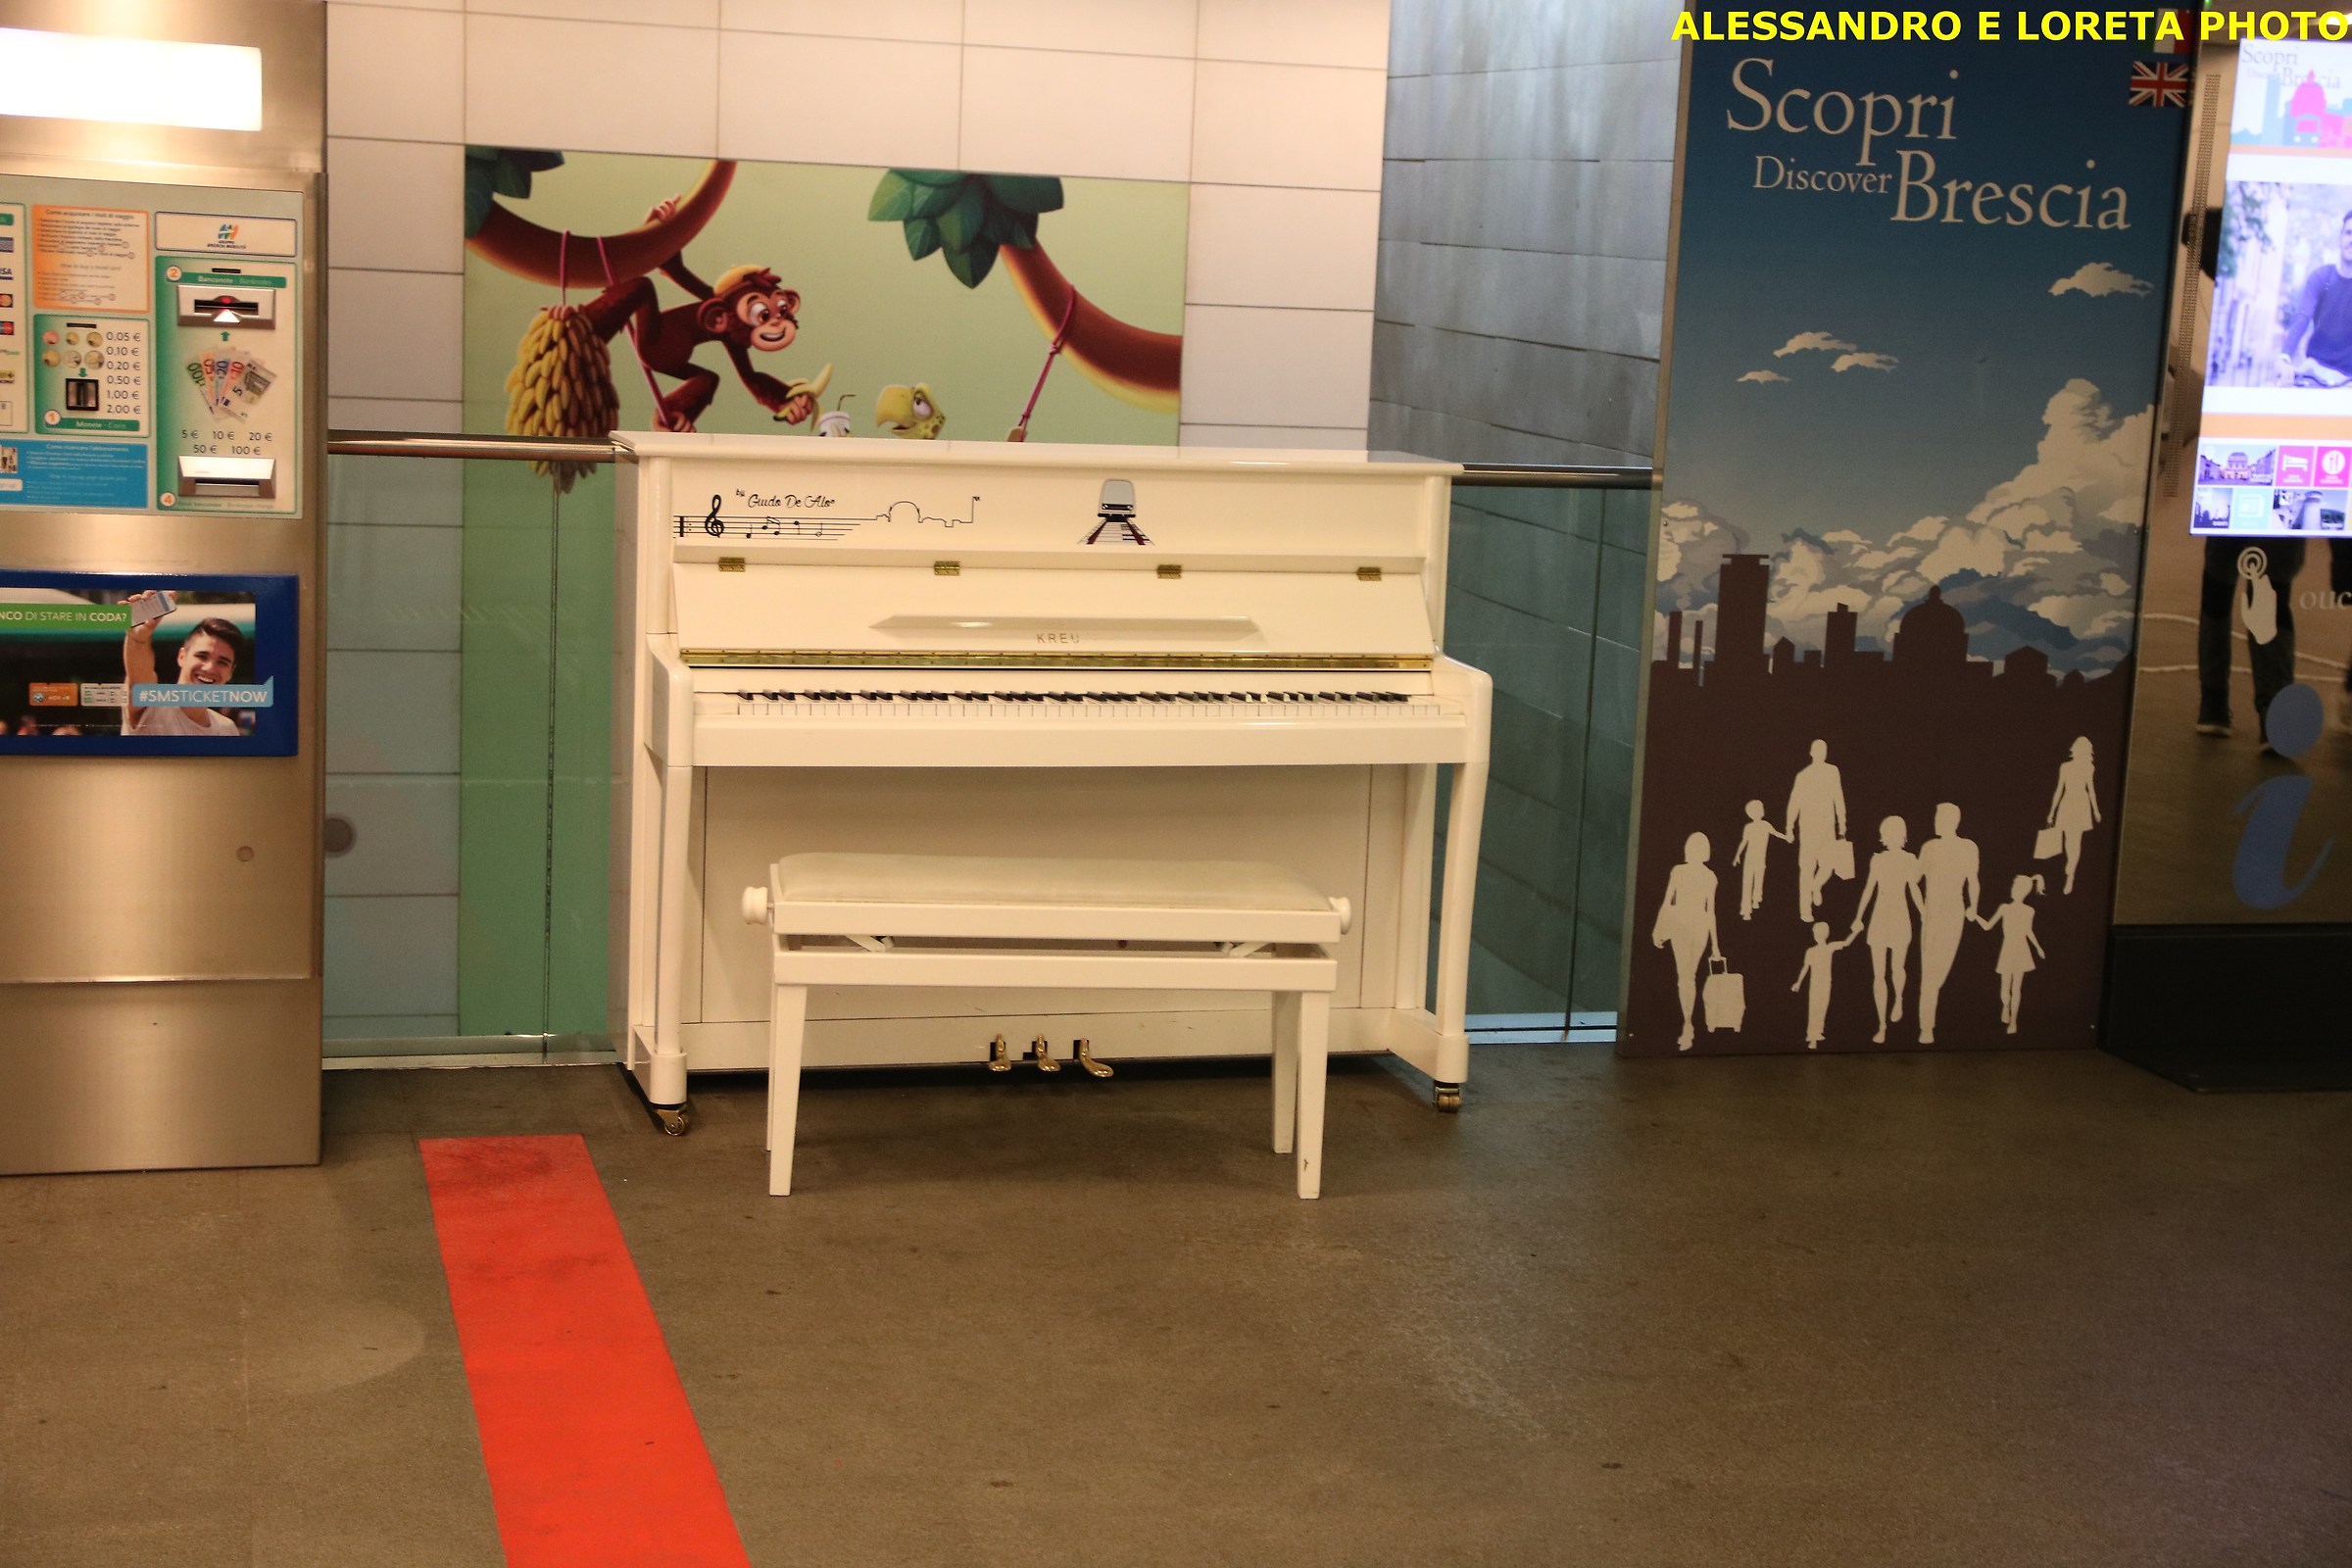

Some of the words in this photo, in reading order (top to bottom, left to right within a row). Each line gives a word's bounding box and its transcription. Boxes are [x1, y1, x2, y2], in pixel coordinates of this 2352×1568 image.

[1727, 57, 1958, 166] Scopri
[1754, 155, 1892, 194] Discover
[1889, 149, 2132, 231] Brescia
[106, 331, 130, 342] 0.05
[106, 346, 128, 356] 0.10
[106, 361, 130, 370] 0.20
[106, 374, 130, 385] 0.50
[107, 389, 129, 400] 1.00
[106, 404, 130, 415] 2.00
[213, 430, 224, 440] 10
[249, 431, 262, 442] 20
[193, 444, 207, 454] 50
[231, 445, 251, 455] 100
[24, 612, 38, 620] DI
[40, 611, 74, 621] STARE
[75, 612, 87, 621] IN
[89, 612, 127, 621] CODA?
[138, 688, 269, 703] #SMSTICKETNOW
